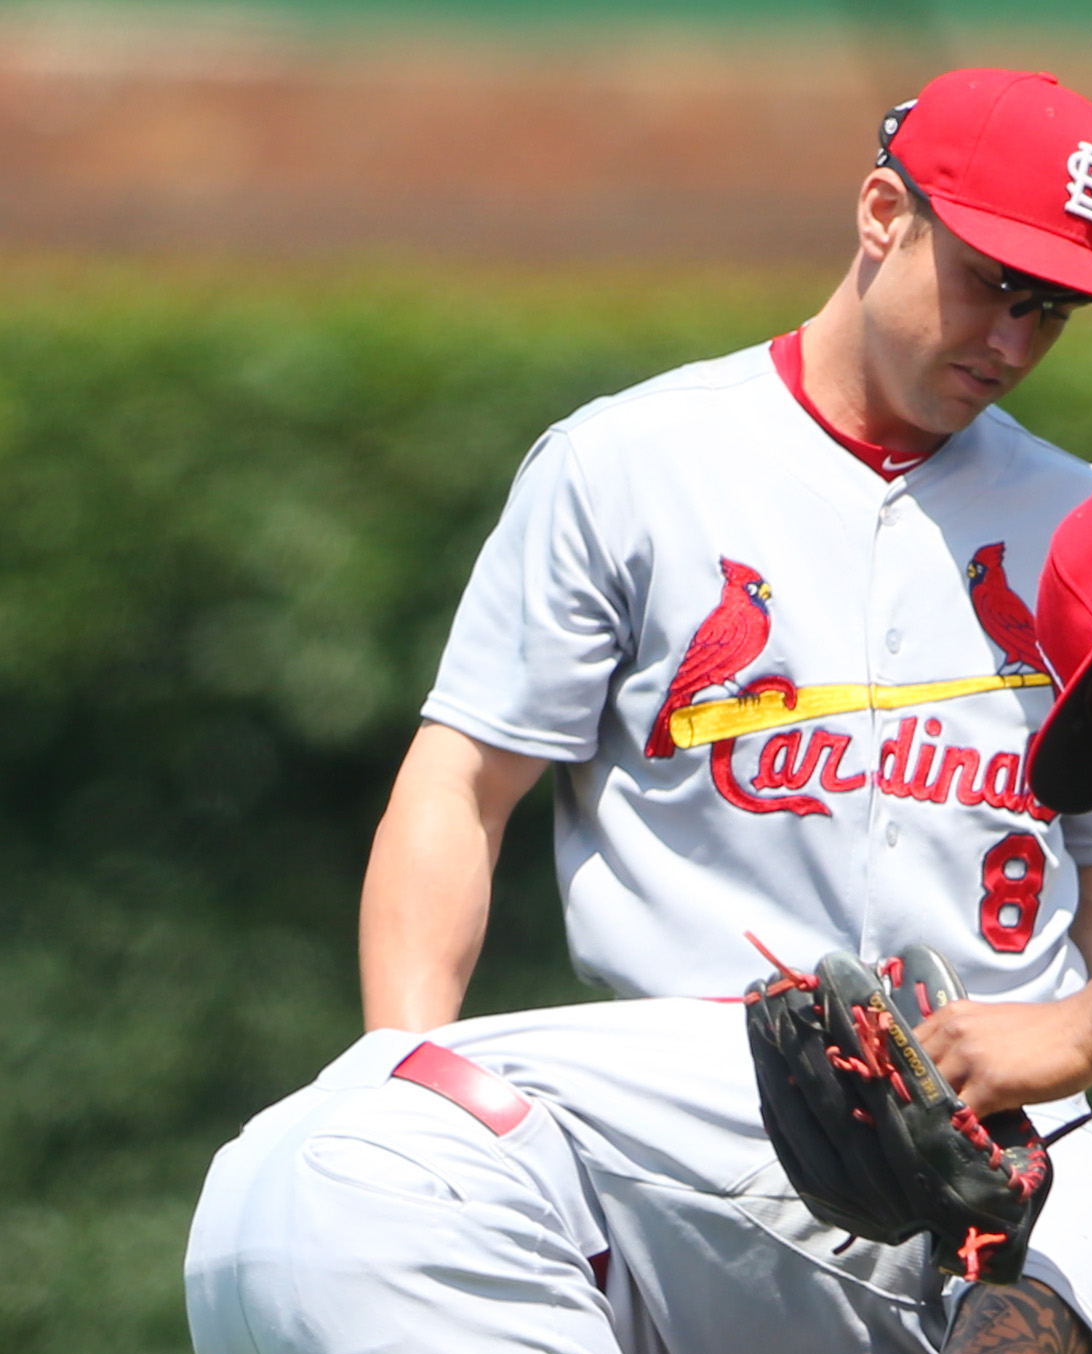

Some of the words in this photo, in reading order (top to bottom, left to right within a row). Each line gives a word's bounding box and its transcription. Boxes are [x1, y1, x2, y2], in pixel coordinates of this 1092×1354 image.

[979, 831, 1046, 954] 8
[903, 1046, 927, 1077] GOLD
[920, 1077, 940, 1101] THE
